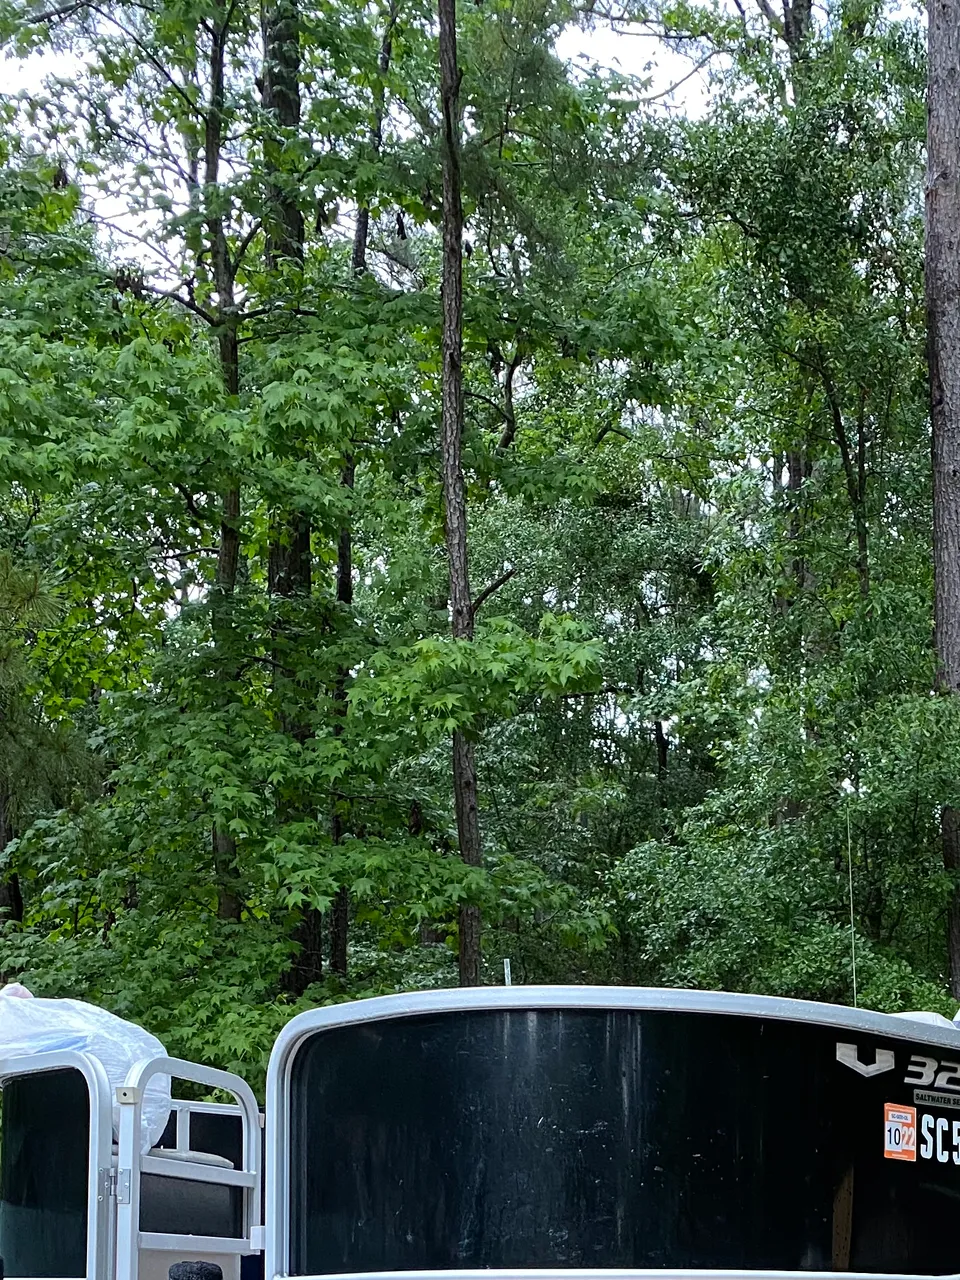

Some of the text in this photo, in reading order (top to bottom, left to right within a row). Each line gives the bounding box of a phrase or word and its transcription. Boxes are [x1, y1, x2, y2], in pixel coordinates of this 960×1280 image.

[915, 1093, 951, 1105] SALTWATER
[887, 1126, 915, 1149] 10 22
